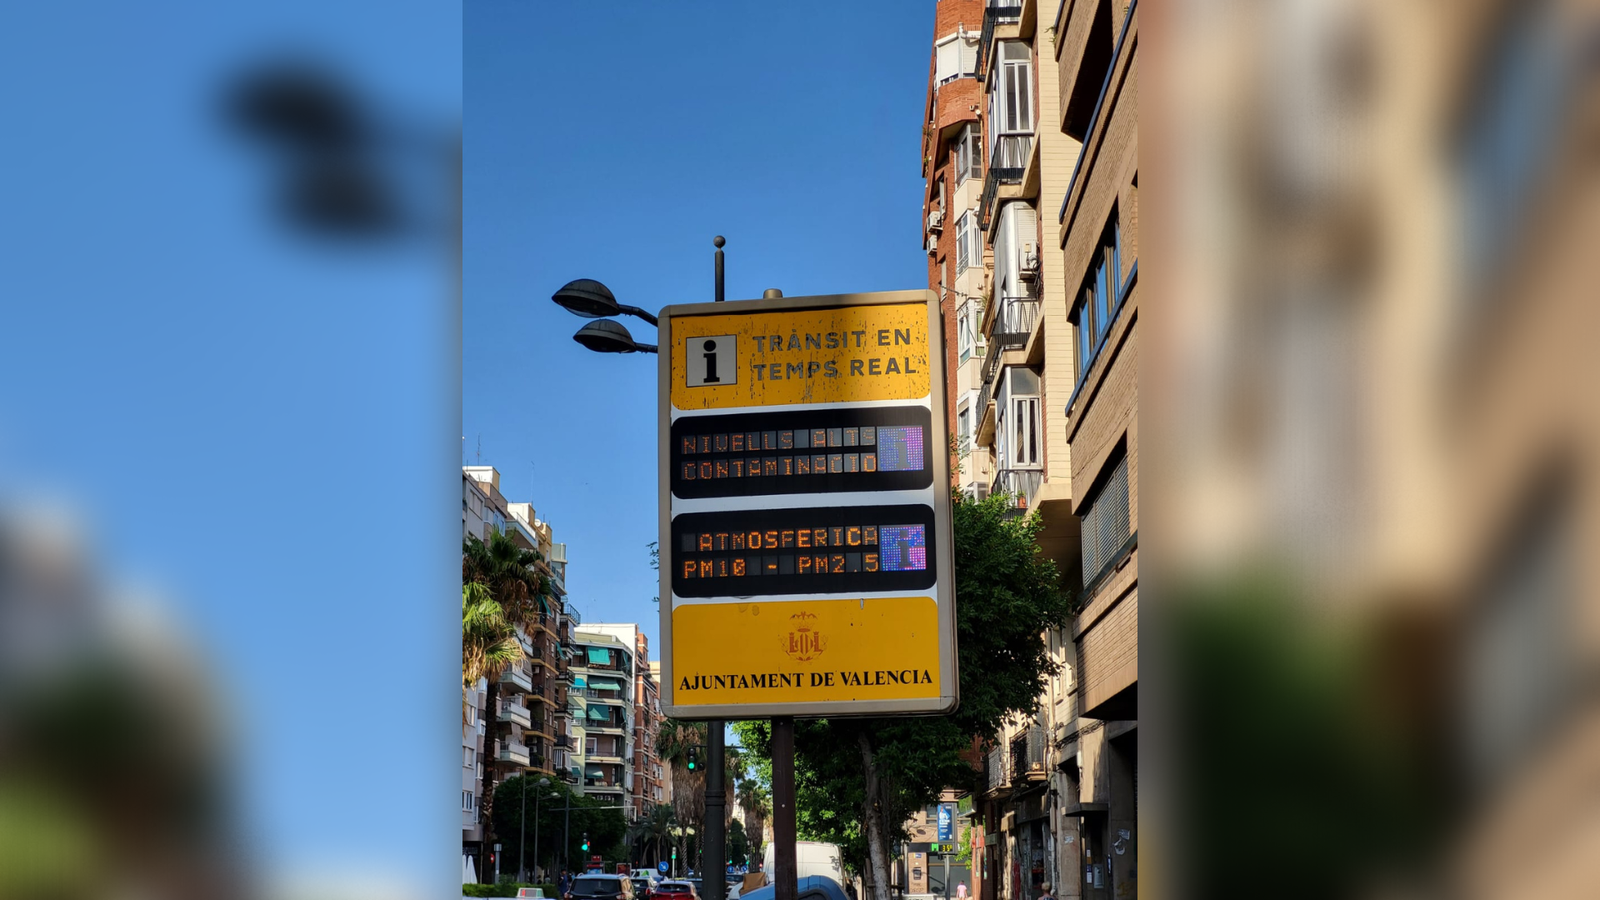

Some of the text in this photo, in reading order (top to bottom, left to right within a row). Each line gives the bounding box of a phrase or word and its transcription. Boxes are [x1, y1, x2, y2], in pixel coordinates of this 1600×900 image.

[877, 328, 911, 347] EN
[753, 357, 917, 381] TEMPS REAL
[683, 428, 876, 455] NIVELLS ALTS
[684, 455, 877, 480] CONTAMINACIO
[700, 527, 878, 551] ATMOSFERICA
[684, 558, 747, 579] PM10
[799, 553, 879, 573] PM2.5
[679, 668, 934, 692] AJUNTAMENT DE VALENCIA
